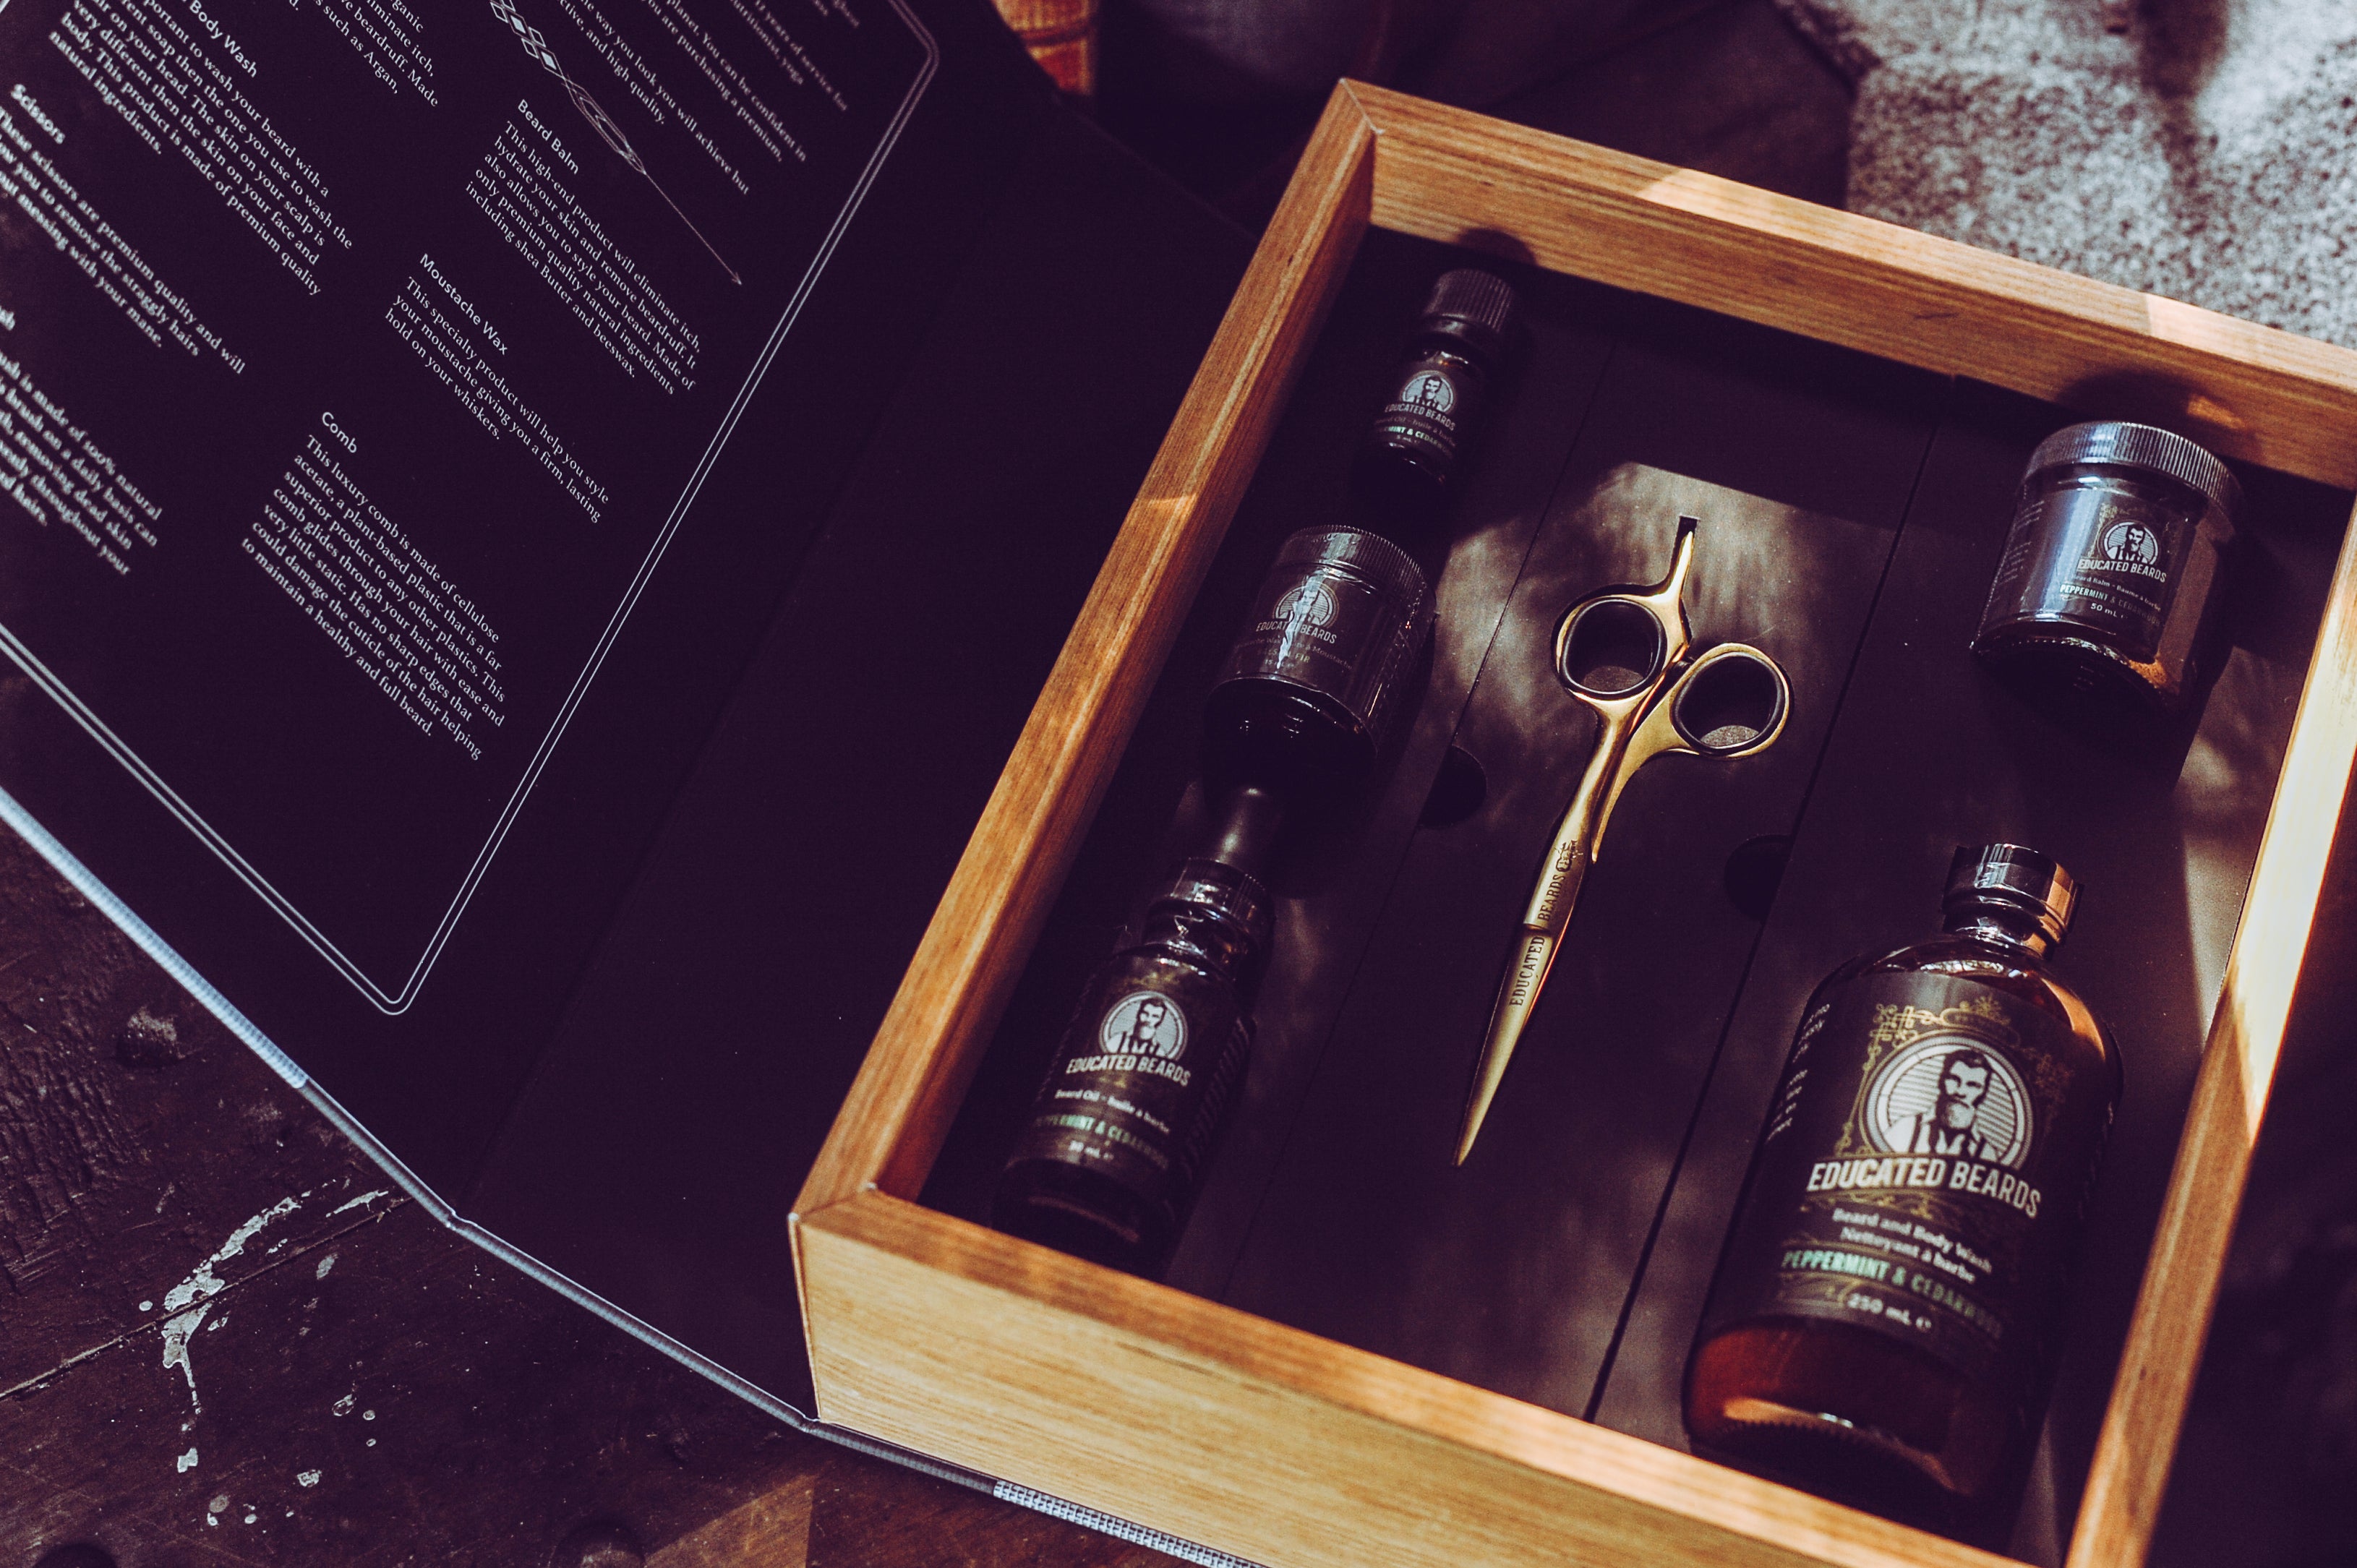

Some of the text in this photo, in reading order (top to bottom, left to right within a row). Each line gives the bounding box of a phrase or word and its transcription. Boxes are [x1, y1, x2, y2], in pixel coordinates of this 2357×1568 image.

[189, 0, 257, 79] Body Wash
[322, 5, 398, 95] such as Argan,
[353, 6, 439, 108] beardruff. Made
[411, 43, 434, 77] itch,
[585, 29, 665, 125] and high quality.
[9, 83, 66, 145] Scissors
[189, 41, 330, 198] to wash your beard with a
[517, 98, 579, 175] Beard Balm
[595, 10, 750, 195] way you look you will achieve but
[465, 180, 636, 379] including shea Butter and beeswax.
[475, 168, 674, 395] only premium quality natural ingredients
[484, 153, 696, 391] also allows you to style your beard. Made of
[494, 134, 696, 370] hydrate your skin and remove beardruff. It
[505, 119, 701, 354] This high-end product will eliminate itch,
[419, 252, 508, 356] Moustache Wax
[384, 307, 500, 441] hold on your whiskers.
[392, 294, 602, 524] your moustache giving you a firm, lasting
[406, 275, 609, 505] This specialty product will help you style
[1426, 408, 1456, 432] BEARDS
[321, 411, 358, 454] Comb
[294, 454, 502, 672] acetate, a plant-based plastic that is a far
[306, 434, 500, 643] This luxury comb is made of cellulose
[2078, 558, 2168, 583] EDUCATED BEARDS
[241, 537, 434, 737] to maintain a healthy and full beard.
[1256, 620, 1338, 644] EDUCAT BEARDS
[2060, 584, 2108, 601] PEPPERMINT
[2091, 602, 2103, 612] 50
[2105, 608, 2118, 618] mL
[1510, 874, 1566, 1006] EDUCATED BEARDS
[1066, 1055, 1192, 1087] EDUCATED BEARDS
[1807, 1158, 2041, 1219] EDUCATED BEARDS
[1781, 1249, 1890, 1282] PEPPERMINT
[1911, 1274, 2002, 1339] CEDAR
